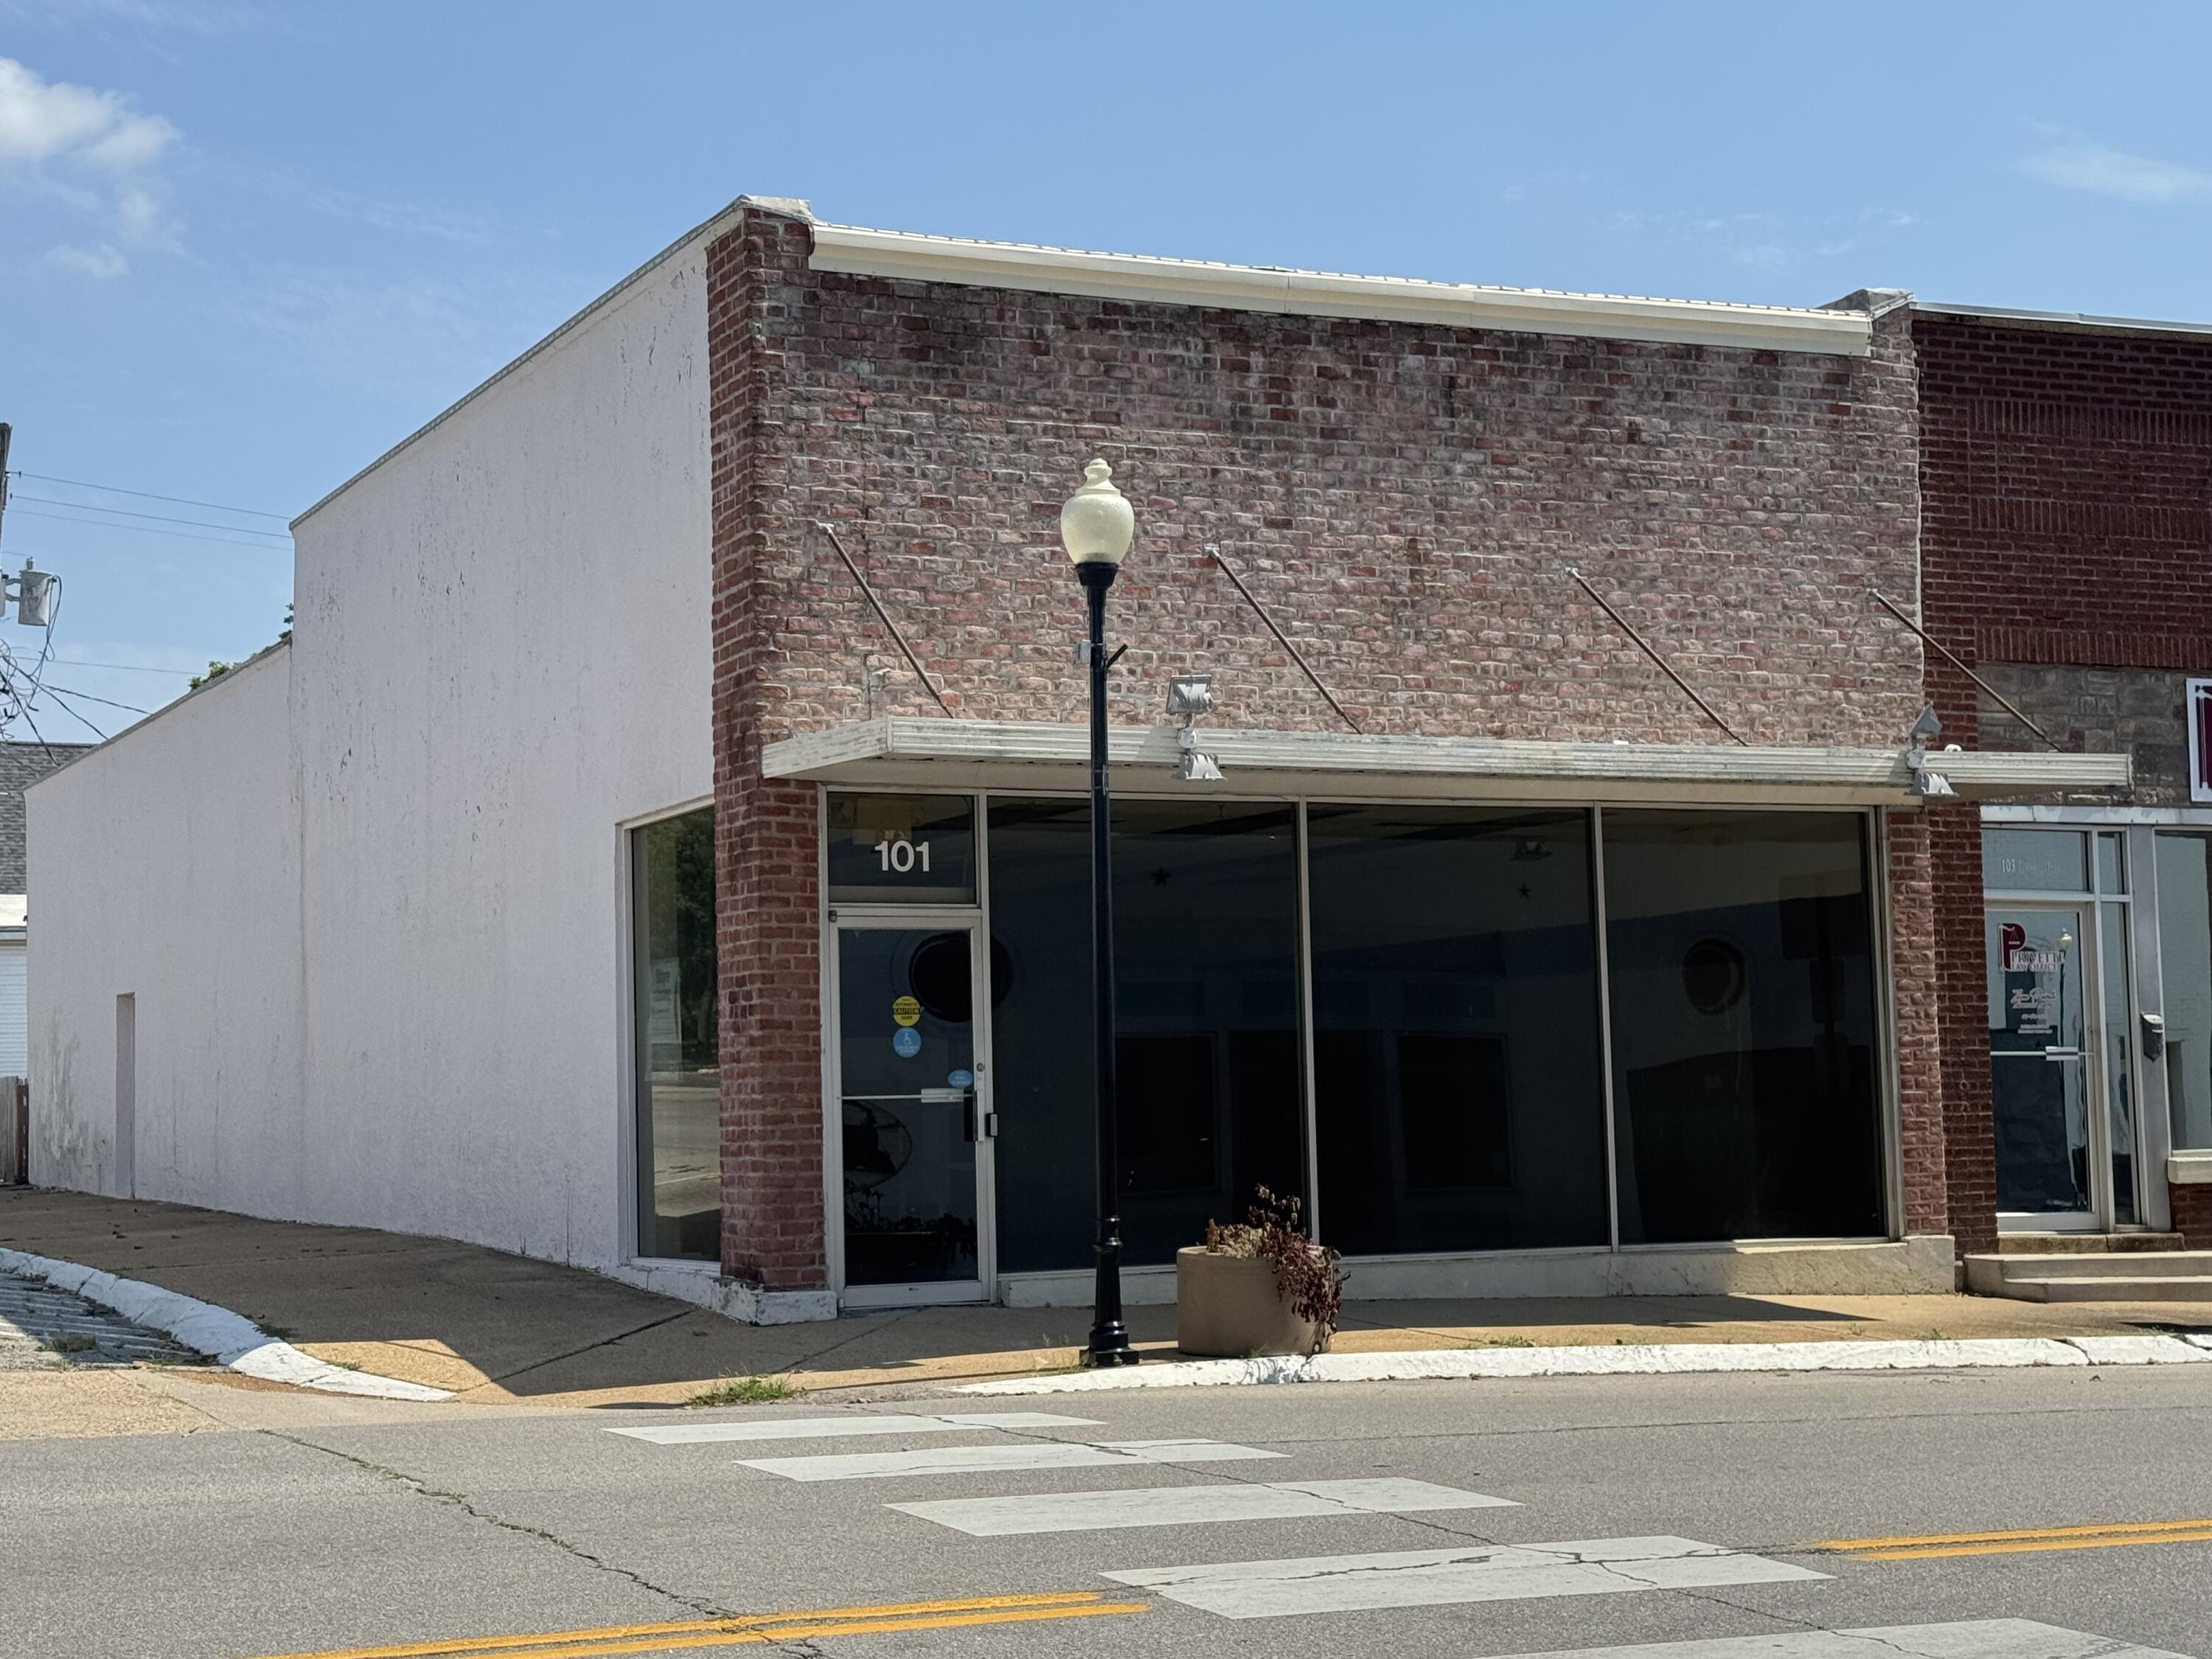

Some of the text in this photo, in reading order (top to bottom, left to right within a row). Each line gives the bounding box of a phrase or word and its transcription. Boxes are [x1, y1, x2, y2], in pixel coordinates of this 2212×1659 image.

[874, 840, 930, 872] 101
[2002, 858, 2015, 873] 103
[2011, 950, 2064, 963] PRIVETTE
[2011, 962, 2056, 971] LAW OFFICE
